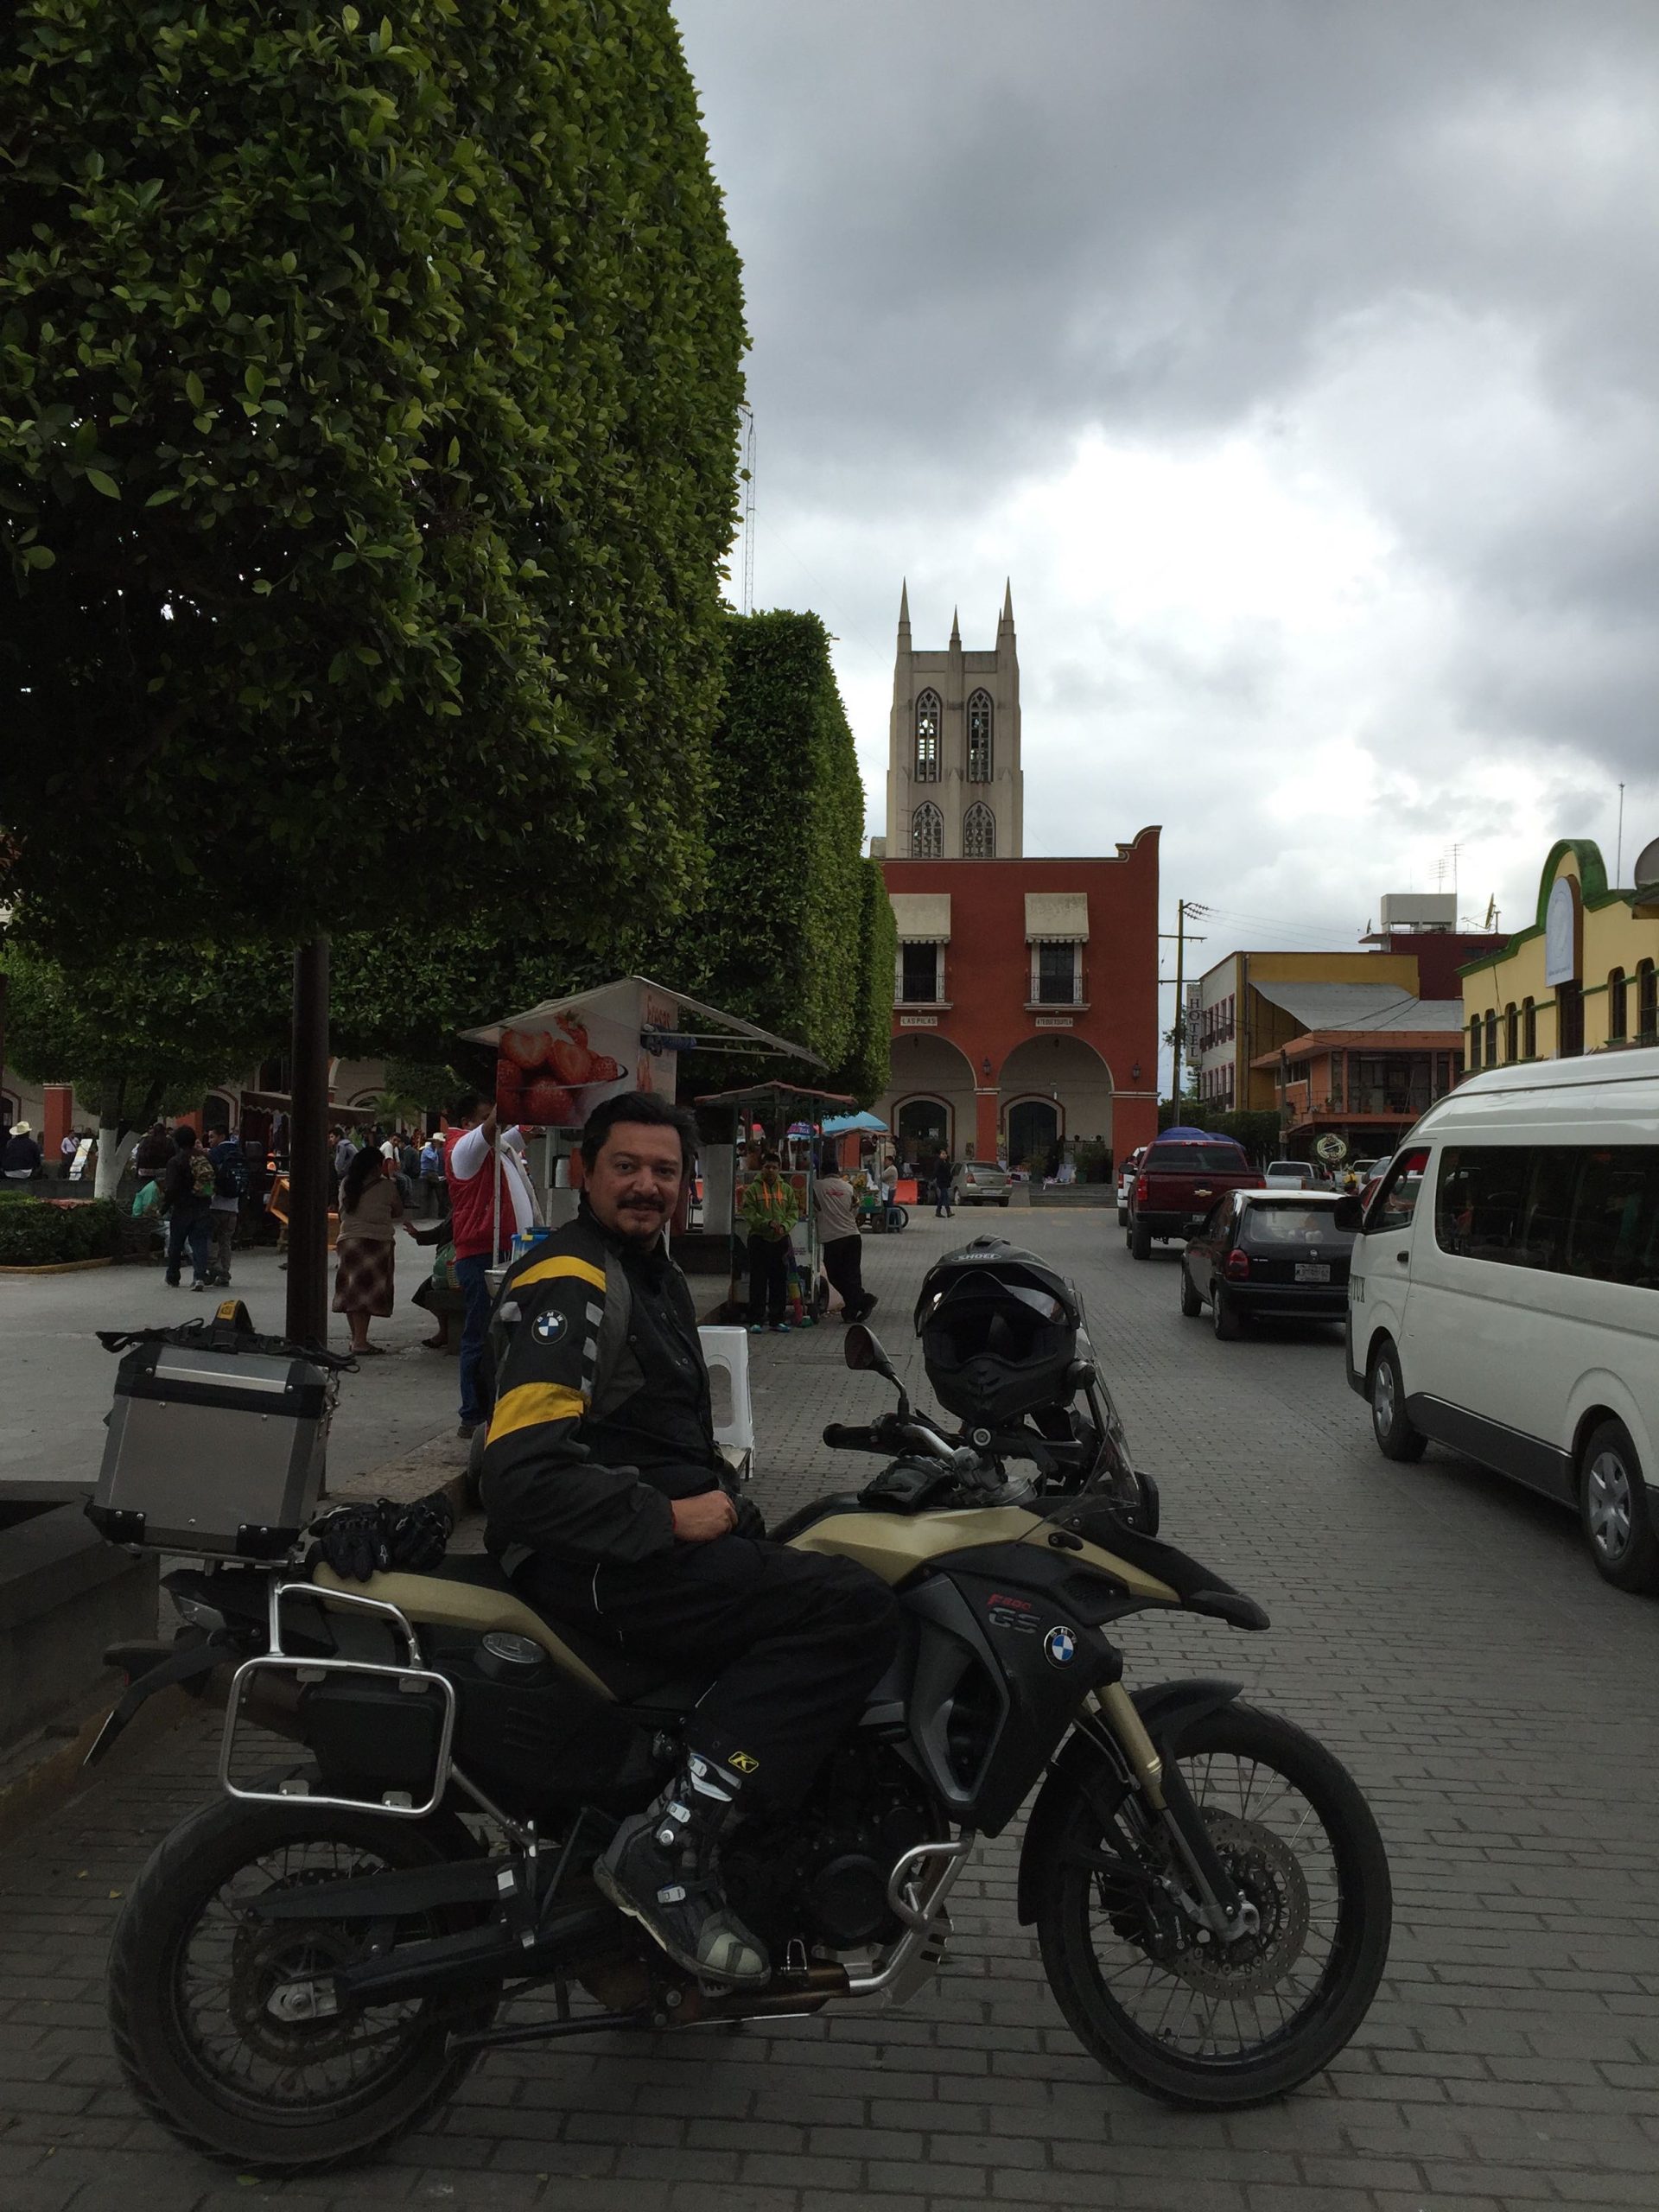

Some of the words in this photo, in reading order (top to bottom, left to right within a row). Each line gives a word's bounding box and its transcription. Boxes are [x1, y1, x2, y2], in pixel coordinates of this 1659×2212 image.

[1189, 999, 1200, 1057] HOTEL
[537, 1311, 564, 1323] BMW
[988, 1607, 1043, 1634] GS
[1049, 1628, 1077, 1644] BMW
